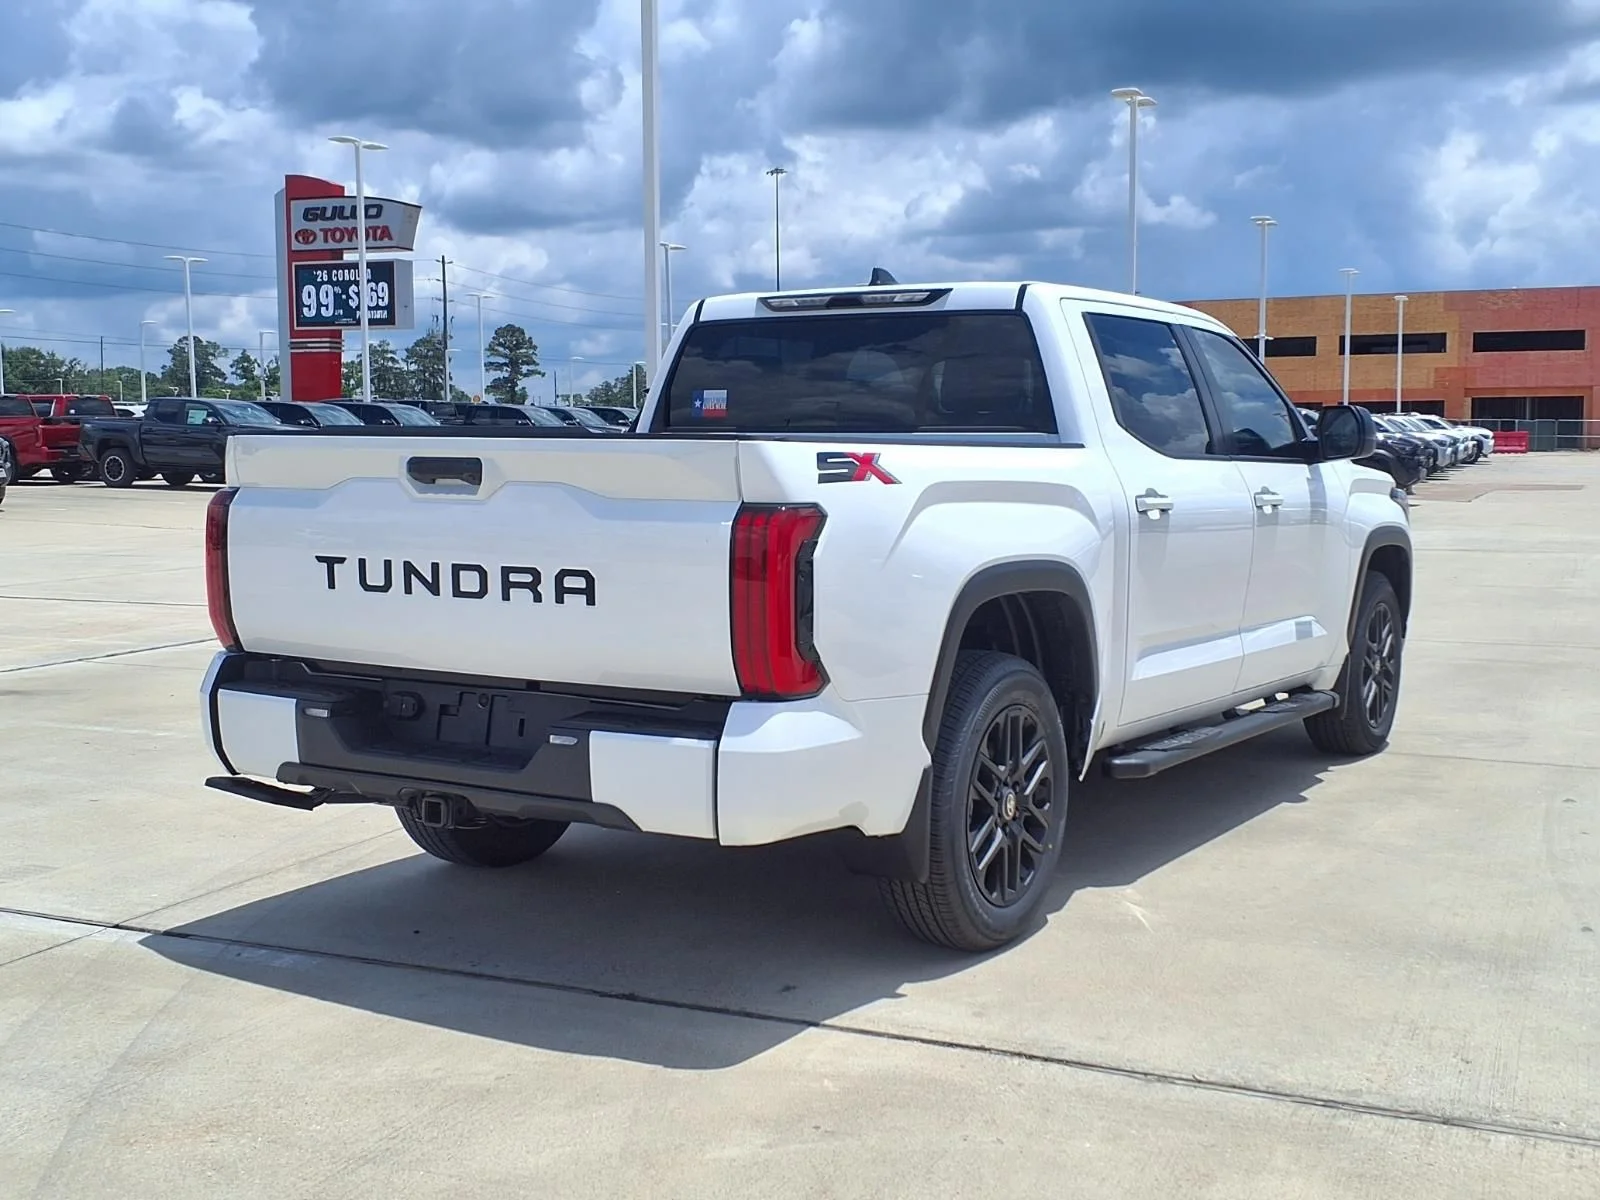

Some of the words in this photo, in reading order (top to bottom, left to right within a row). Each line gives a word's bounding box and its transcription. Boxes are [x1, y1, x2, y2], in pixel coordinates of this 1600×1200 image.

[332, 268, 372, 281] COROLA
[348, 281, 389, 309] $69
[315, 555, 596, 606] TUNDRA
